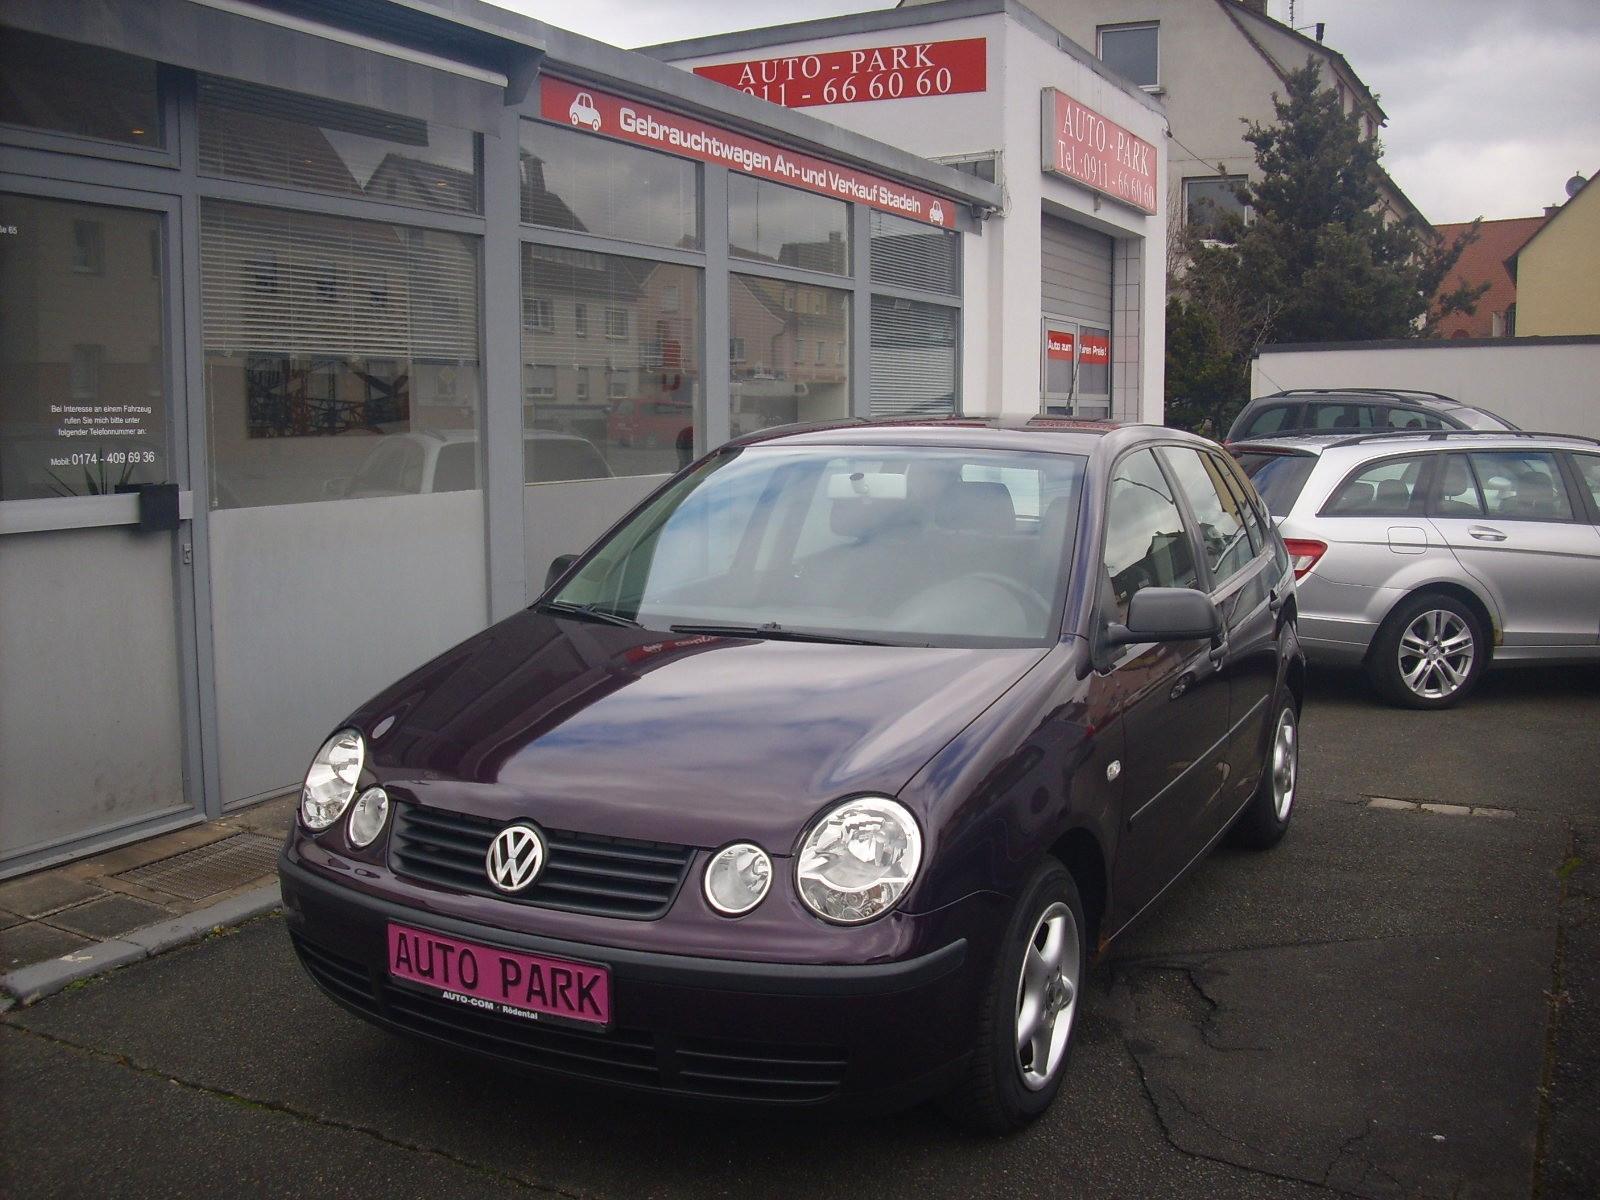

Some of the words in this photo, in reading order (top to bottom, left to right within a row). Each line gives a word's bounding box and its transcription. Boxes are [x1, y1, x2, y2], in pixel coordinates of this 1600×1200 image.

[738, 56, 821, 85] AUTO
[850, 44, 935, 73] PARK
[823, 76, 857, 103] 66
[869, 72, 904, 99] 60
[916, 67, 951, 95] 60
[1063, 103, 1106, 152] AUTO
[1117, 132, 1149, 176] PARK
[619, 107, 771, 171] Gebrauchtwagen
[829, 171, 878, 201] Verkauf
[879, 186, 921, 214] Stadeln
[1118, 171, 1130, 198] 66
[1131, 178, 1142, 204] 60
[1143, 184, 1154, 210] 60
[1048, 339, 1061, 351] Auto
[51, 405, 62, 413] Bei
[63, 405, 93, 413] Interesse
[103, 405, 122, 413] einem
[123, 405, 152, 414] Fahrzeug
[58, 428, 89, 437] folgender
[90, 428, 136, 436] Telefonnummer
[72, 453, 98, 466] 0174
[106, 452, 126, 464] 409
[127, 451, 141, 463] 69
[142, 451, 155, 463] 36
[487, 826, 543, 891] VW
[395, 932, 479, 990] AUTO
[499, 956, 603, 1016] PARK
[442, 990, 494, 1010] AUTO-COM
[502, 1005, 538, 1020] Rödental
